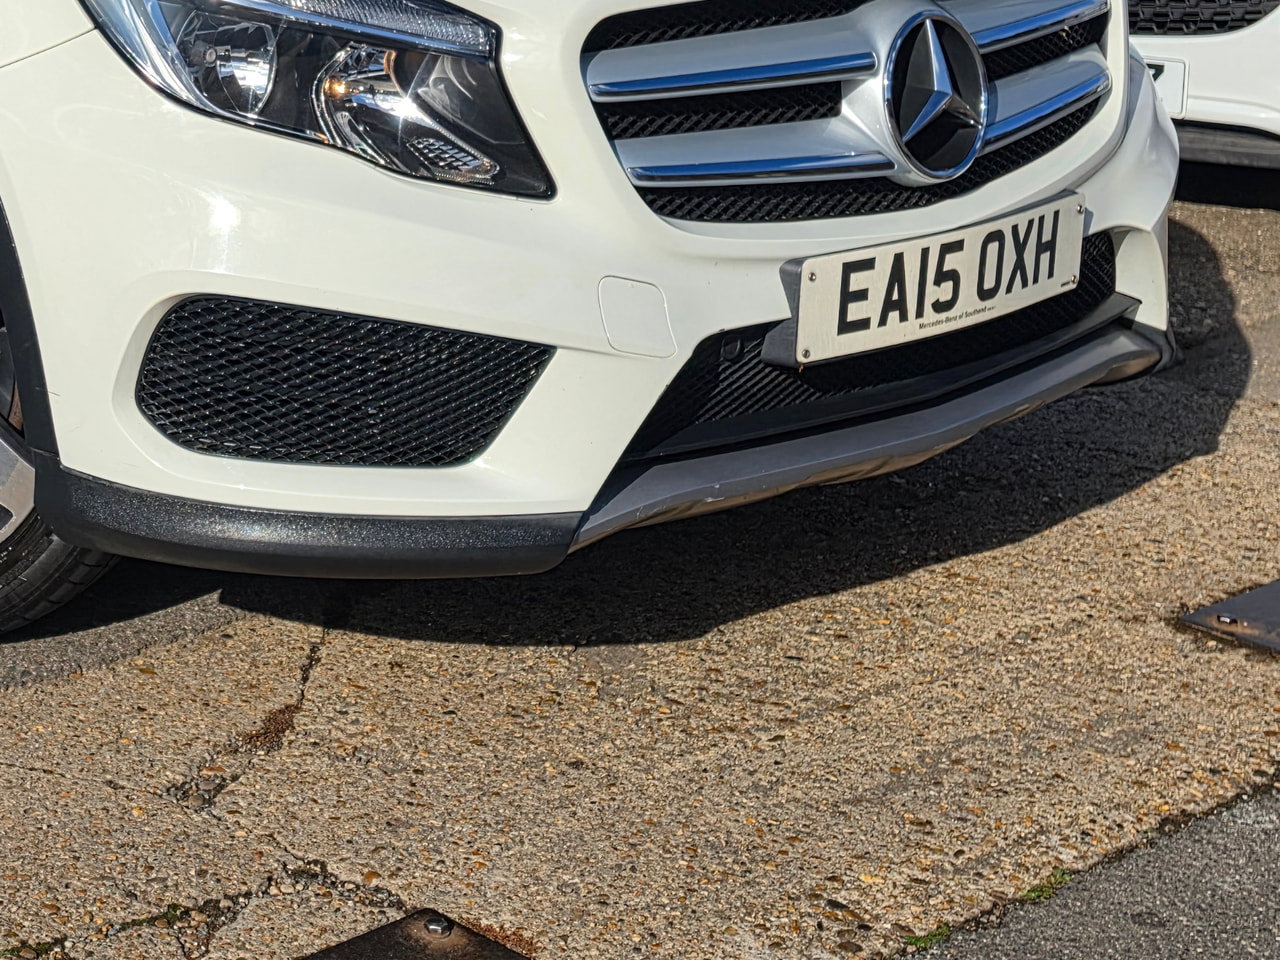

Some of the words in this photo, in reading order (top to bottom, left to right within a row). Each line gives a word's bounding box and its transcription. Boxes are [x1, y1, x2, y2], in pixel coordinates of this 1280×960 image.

[837, 239, 965, 336] EA15
[976, 209, 1060, 302] OXH
[918, 316, 958, 330] Mercedes-Benz
